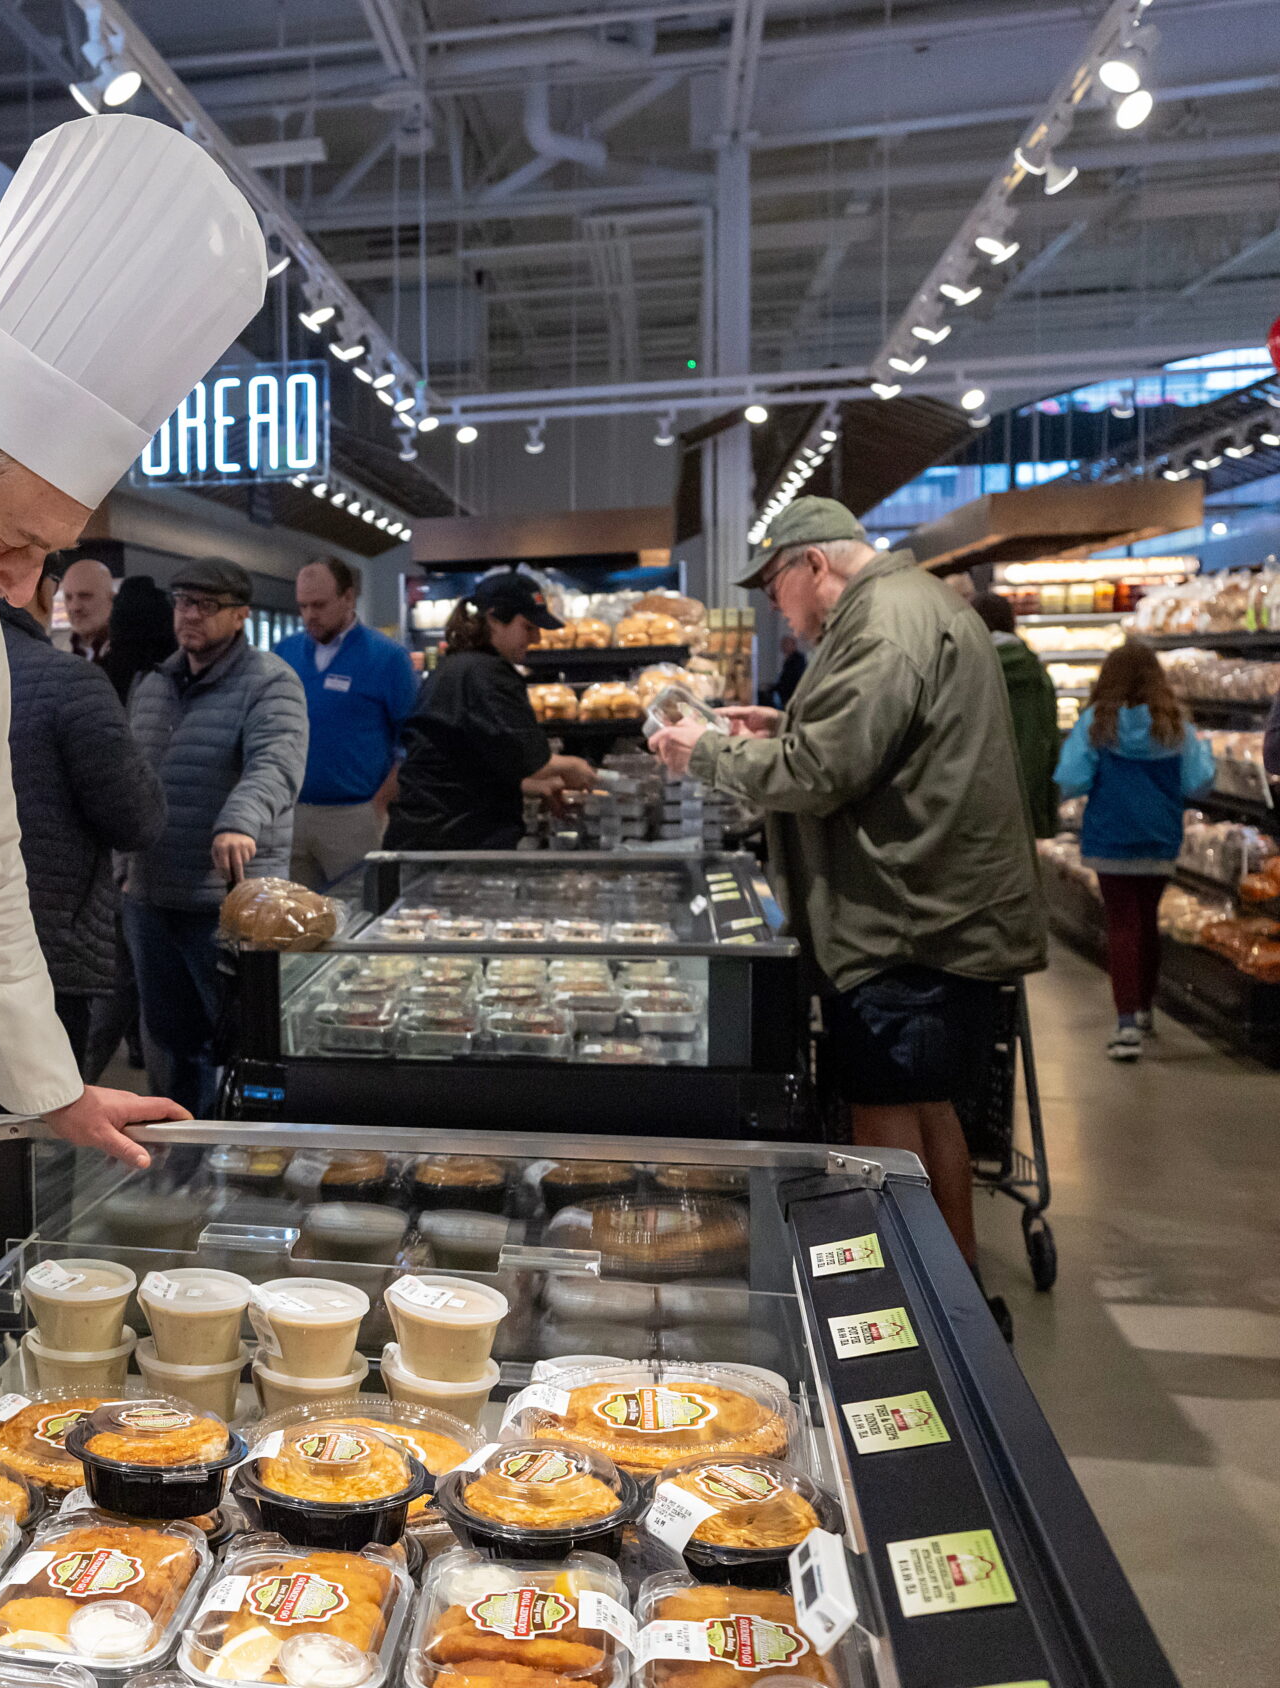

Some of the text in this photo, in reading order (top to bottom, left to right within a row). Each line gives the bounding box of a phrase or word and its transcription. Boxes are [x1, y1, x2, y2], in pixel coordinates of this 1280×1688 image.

[864, 1412, 882, 1436] DINNER
[875, 1404, 889, 1417] FISH
[883, 1422, 899, 1440] CHIPS
[288, 1577, 307, 1601] GOURMET
[280, 1610, 290, 1619] GO
[517, 1606, 529, 1633] GOURMET
[740, 1618, 752, 1664] GOURMET TO GO
